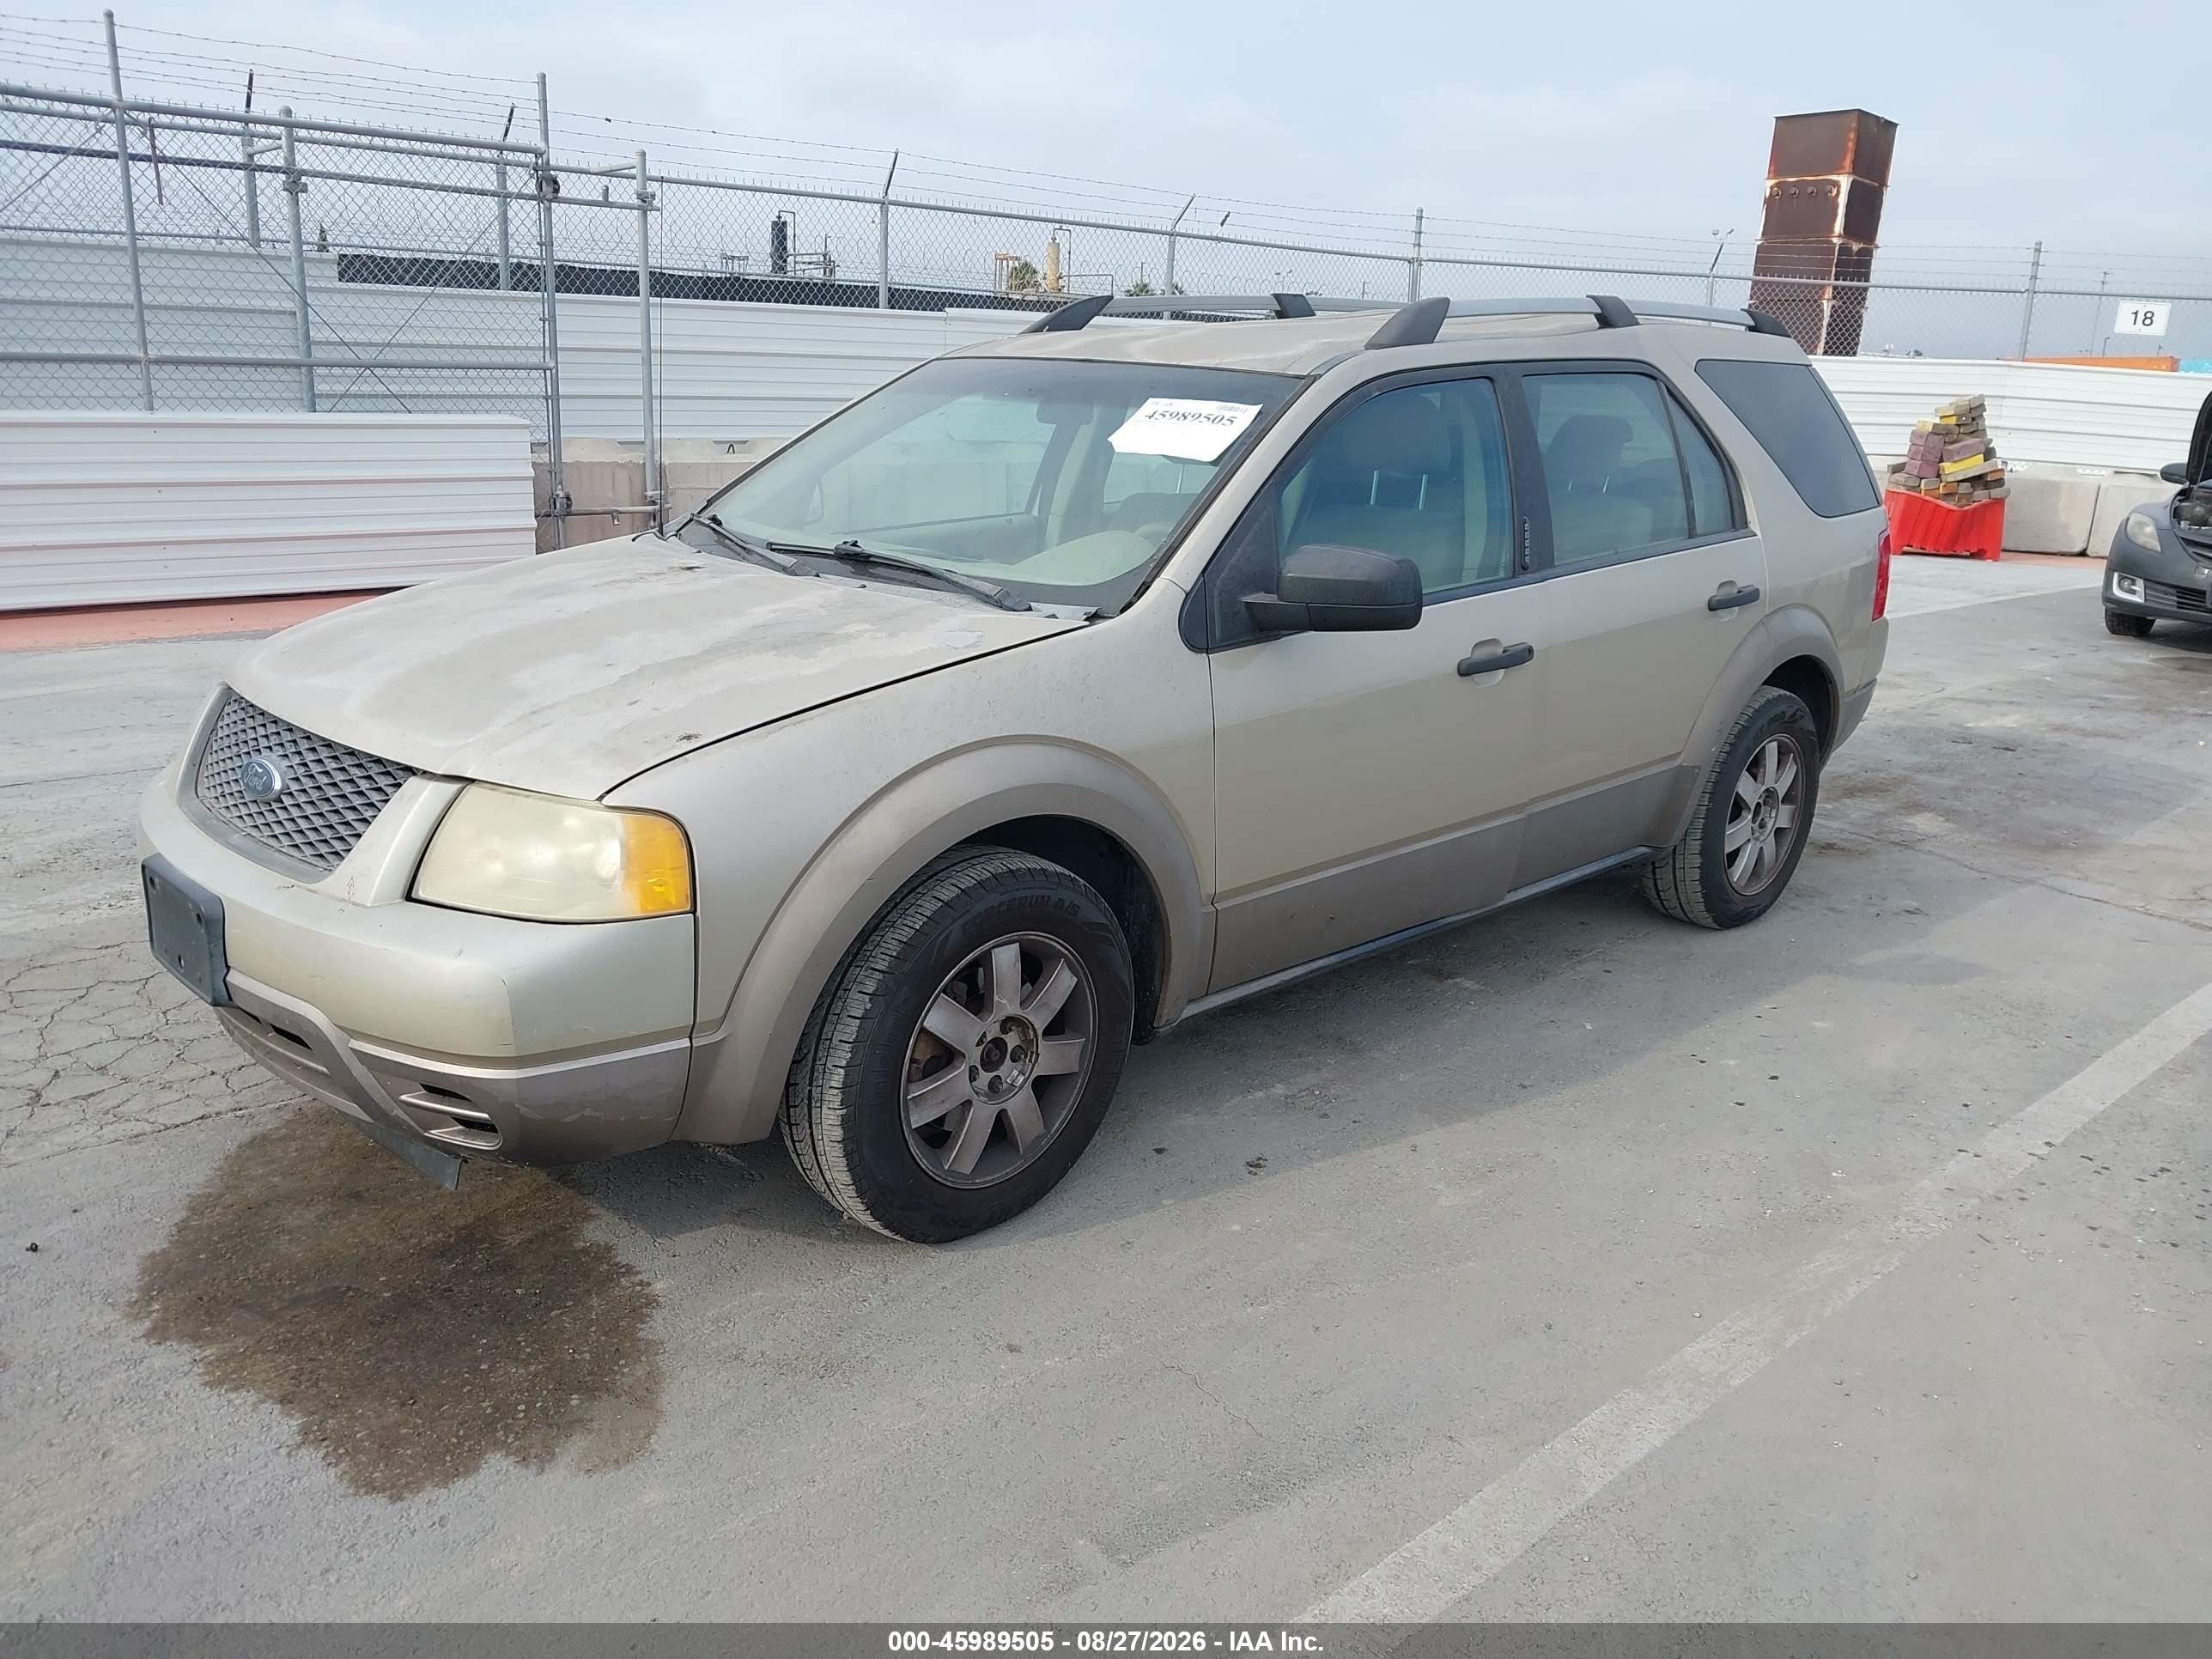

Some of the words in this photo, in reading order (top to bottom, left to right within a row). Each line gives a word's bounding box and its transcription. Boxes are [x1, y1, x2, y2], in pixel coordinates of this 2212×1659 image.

[2130, 309, 2155, 327] 18
[1144, 410, 1238, 427] 45989505
[244, 763, 267, 792] Ford
